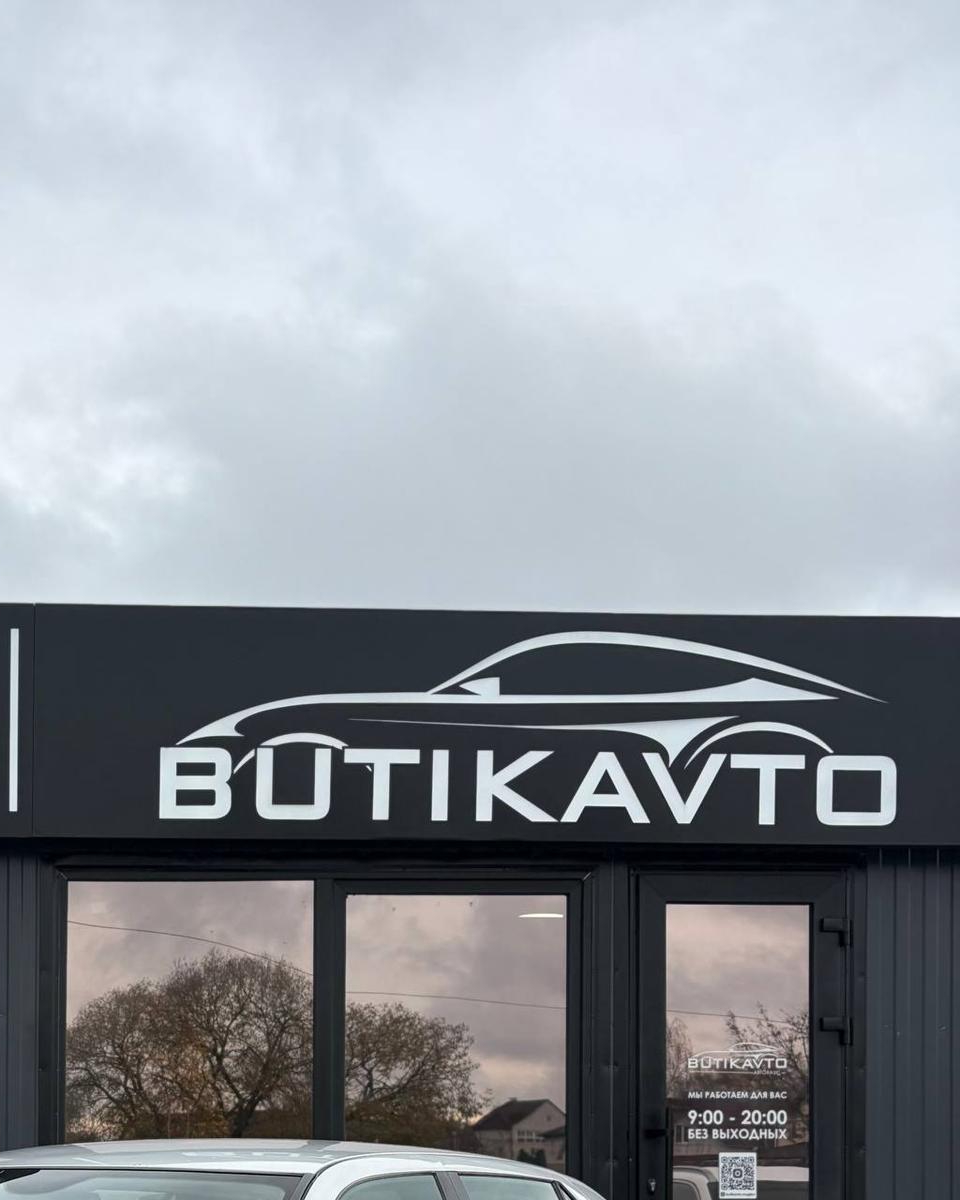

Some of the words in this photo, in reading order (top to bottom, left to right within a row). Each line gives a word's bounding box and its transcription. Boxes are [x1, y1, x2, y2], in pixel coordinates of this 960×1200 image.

[158, 746, 897, 827] BUTIKAVTO
[688, 1057, 788, 1069] BUTIKAVTO
[688, 1091, 703, 1099] МЫ
[705, 1091, 748, 1099] РАБОТАЕМ
[750, 1091, 767, 1099] ДЛЯ
[770, 1091, 787, 1099] ВАС
[688, 1109, 723, 1125] 9:00
[741, 1109, 787, 1125] 20:00
[688, 1128, 708, 1139] БЕЗ
[712, 1128, 787, 1140] ВЫХОДНЫХ
